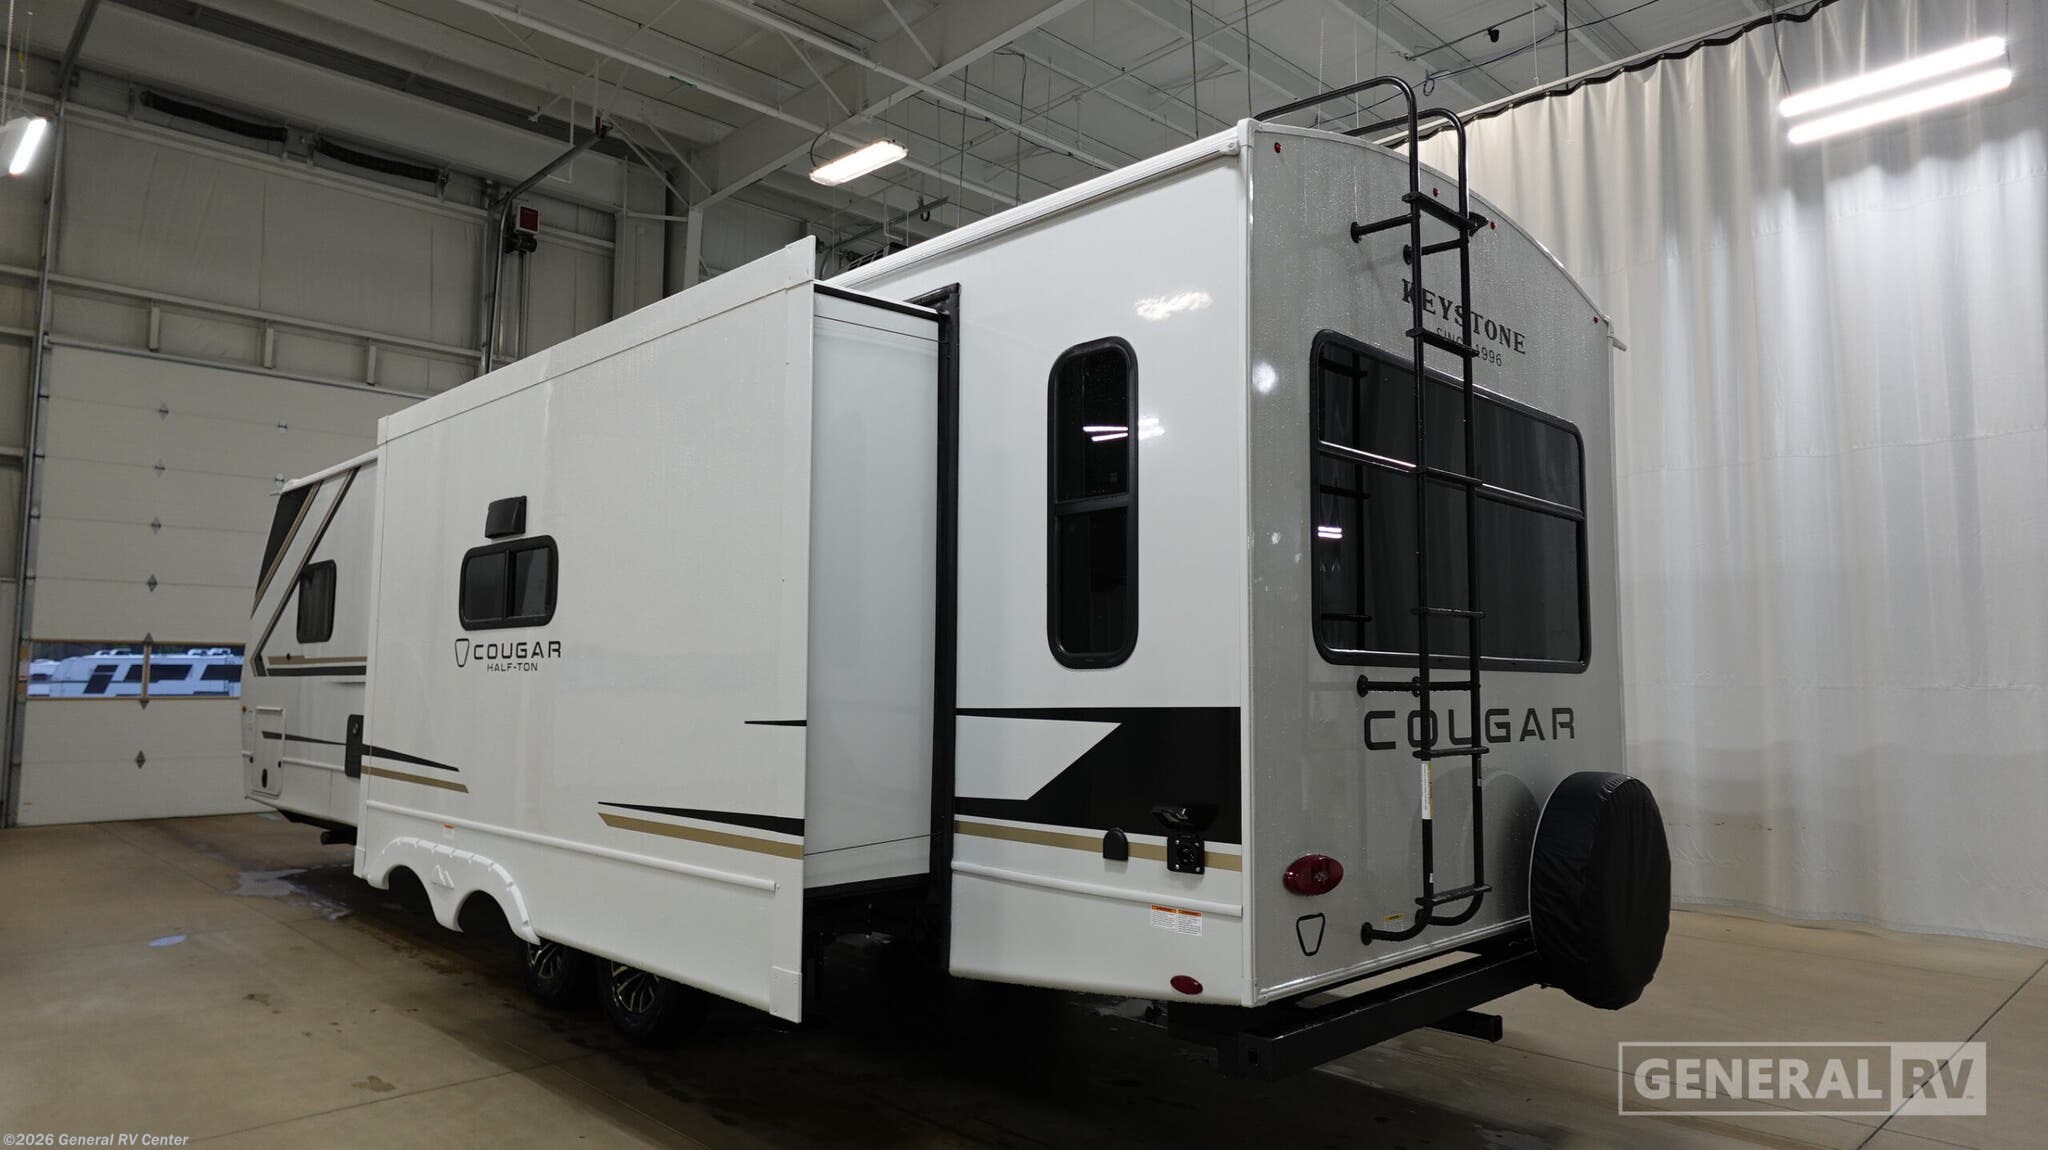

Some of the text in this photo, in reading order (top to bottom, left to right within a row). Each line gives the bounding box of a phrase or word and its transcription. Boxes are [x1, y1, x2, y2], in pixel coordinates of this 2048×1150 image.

[1402, 278, 1526, 354] KEYSTONE
[474, 641, 561, 660] COUGAR
[487, 662, 538, 672] HALF-TON
[1364, 707, 1575, 750] COUGAR
